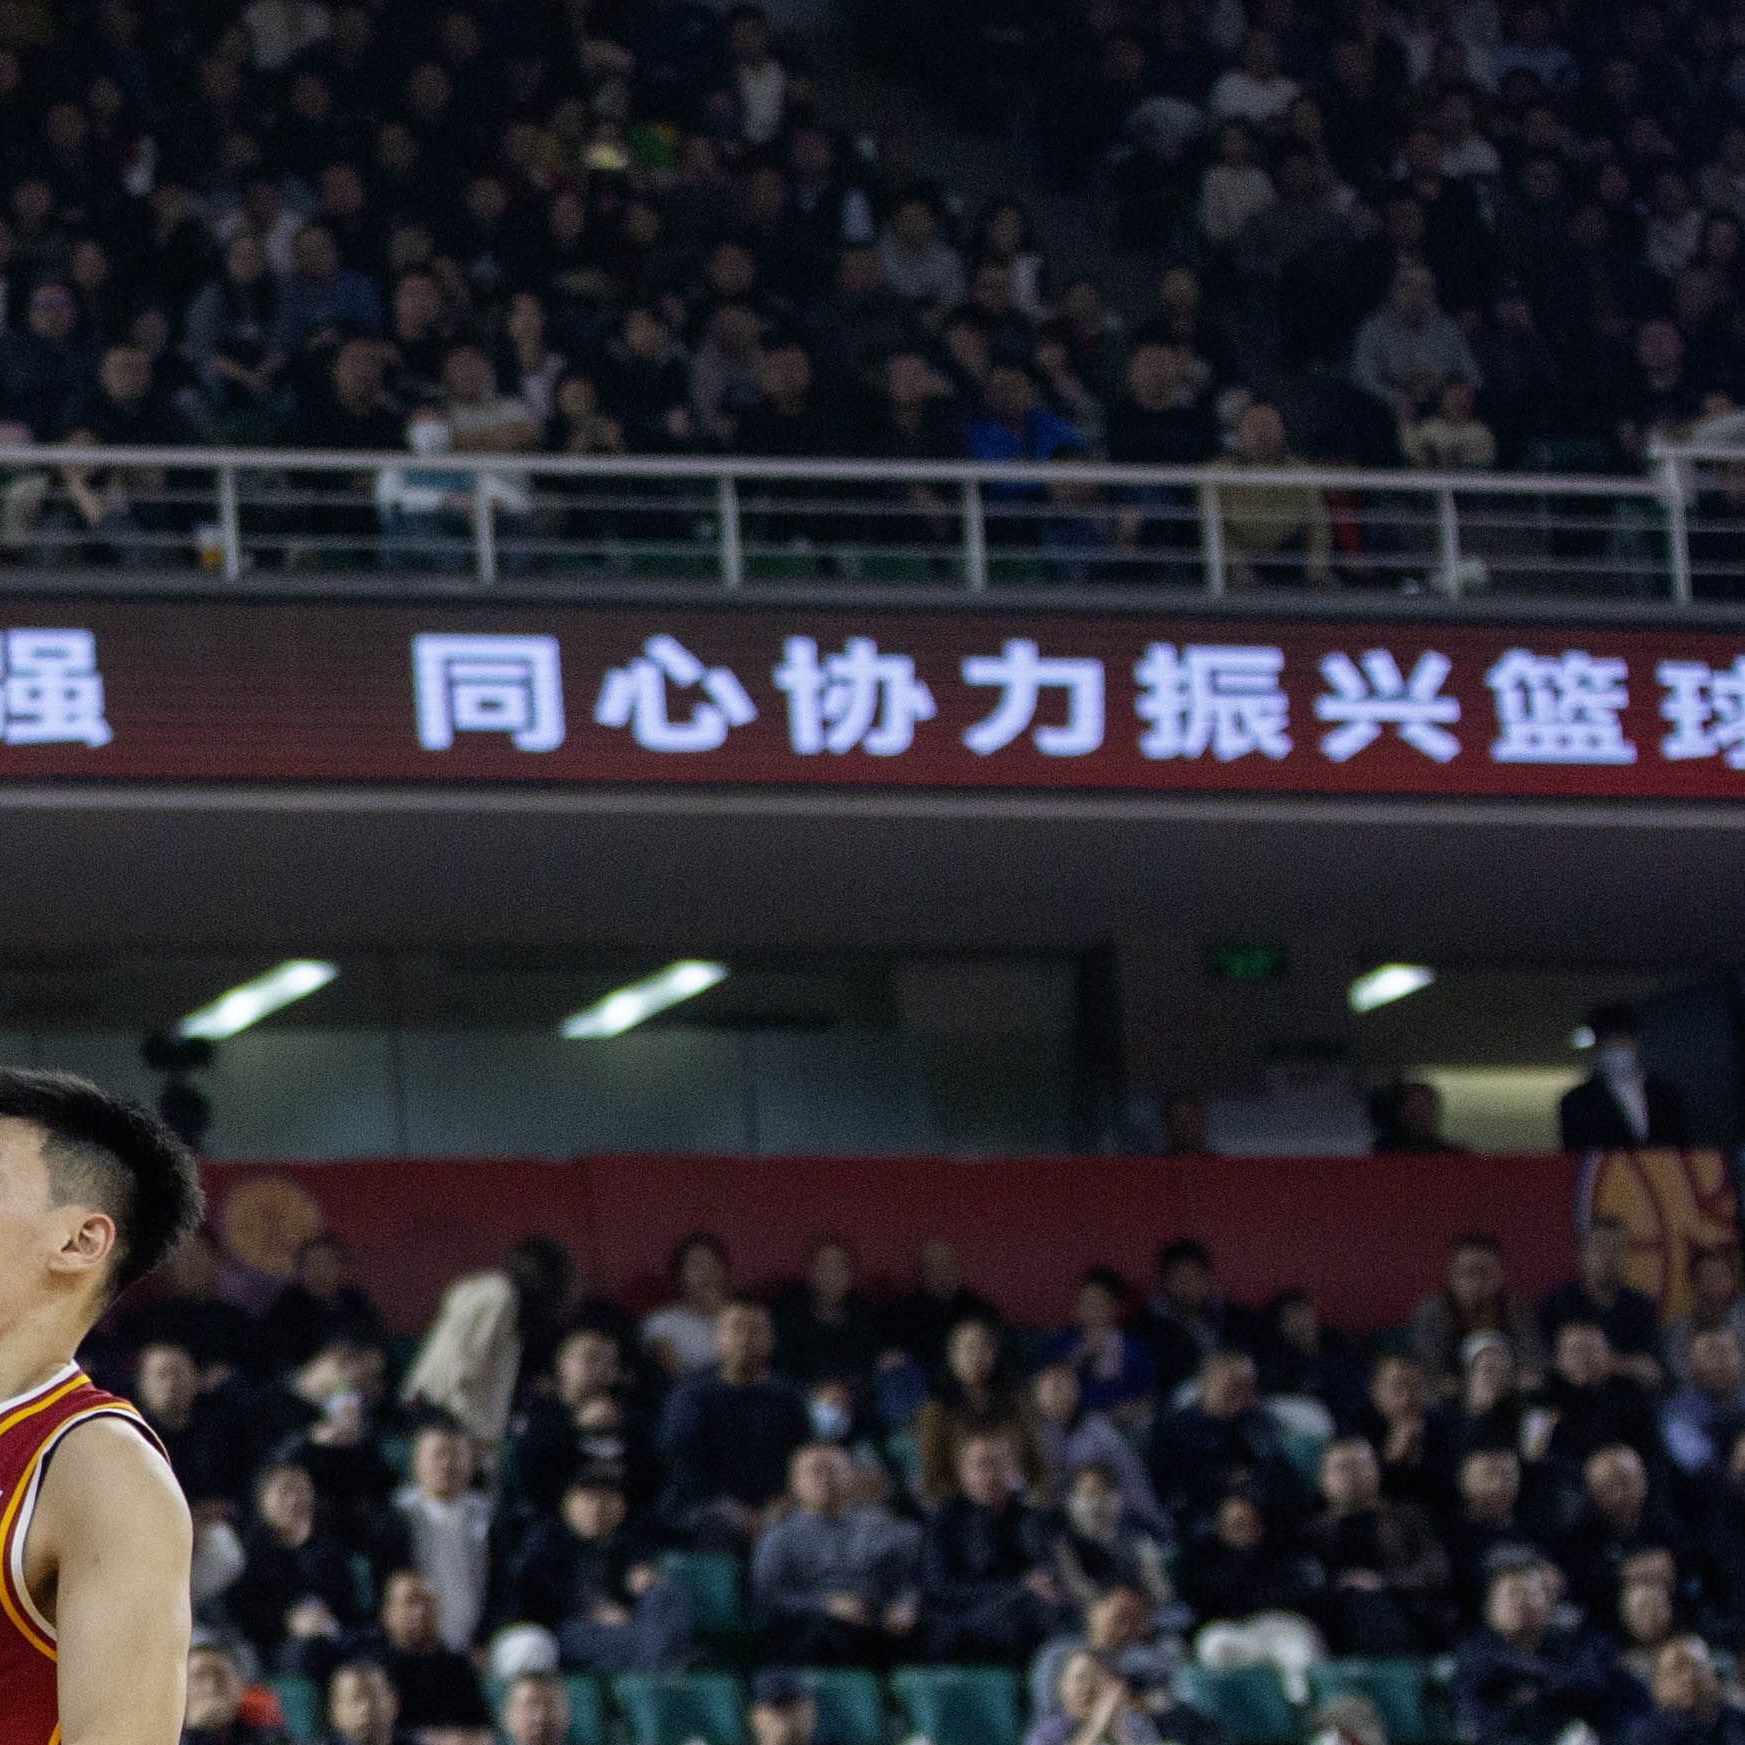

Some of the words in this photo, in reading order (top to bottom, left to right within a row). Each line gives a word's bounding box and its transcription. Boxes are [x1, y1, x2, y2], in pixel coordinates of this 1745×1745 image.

[411, 632, 1745, 770] 同心协力振兴篮球
